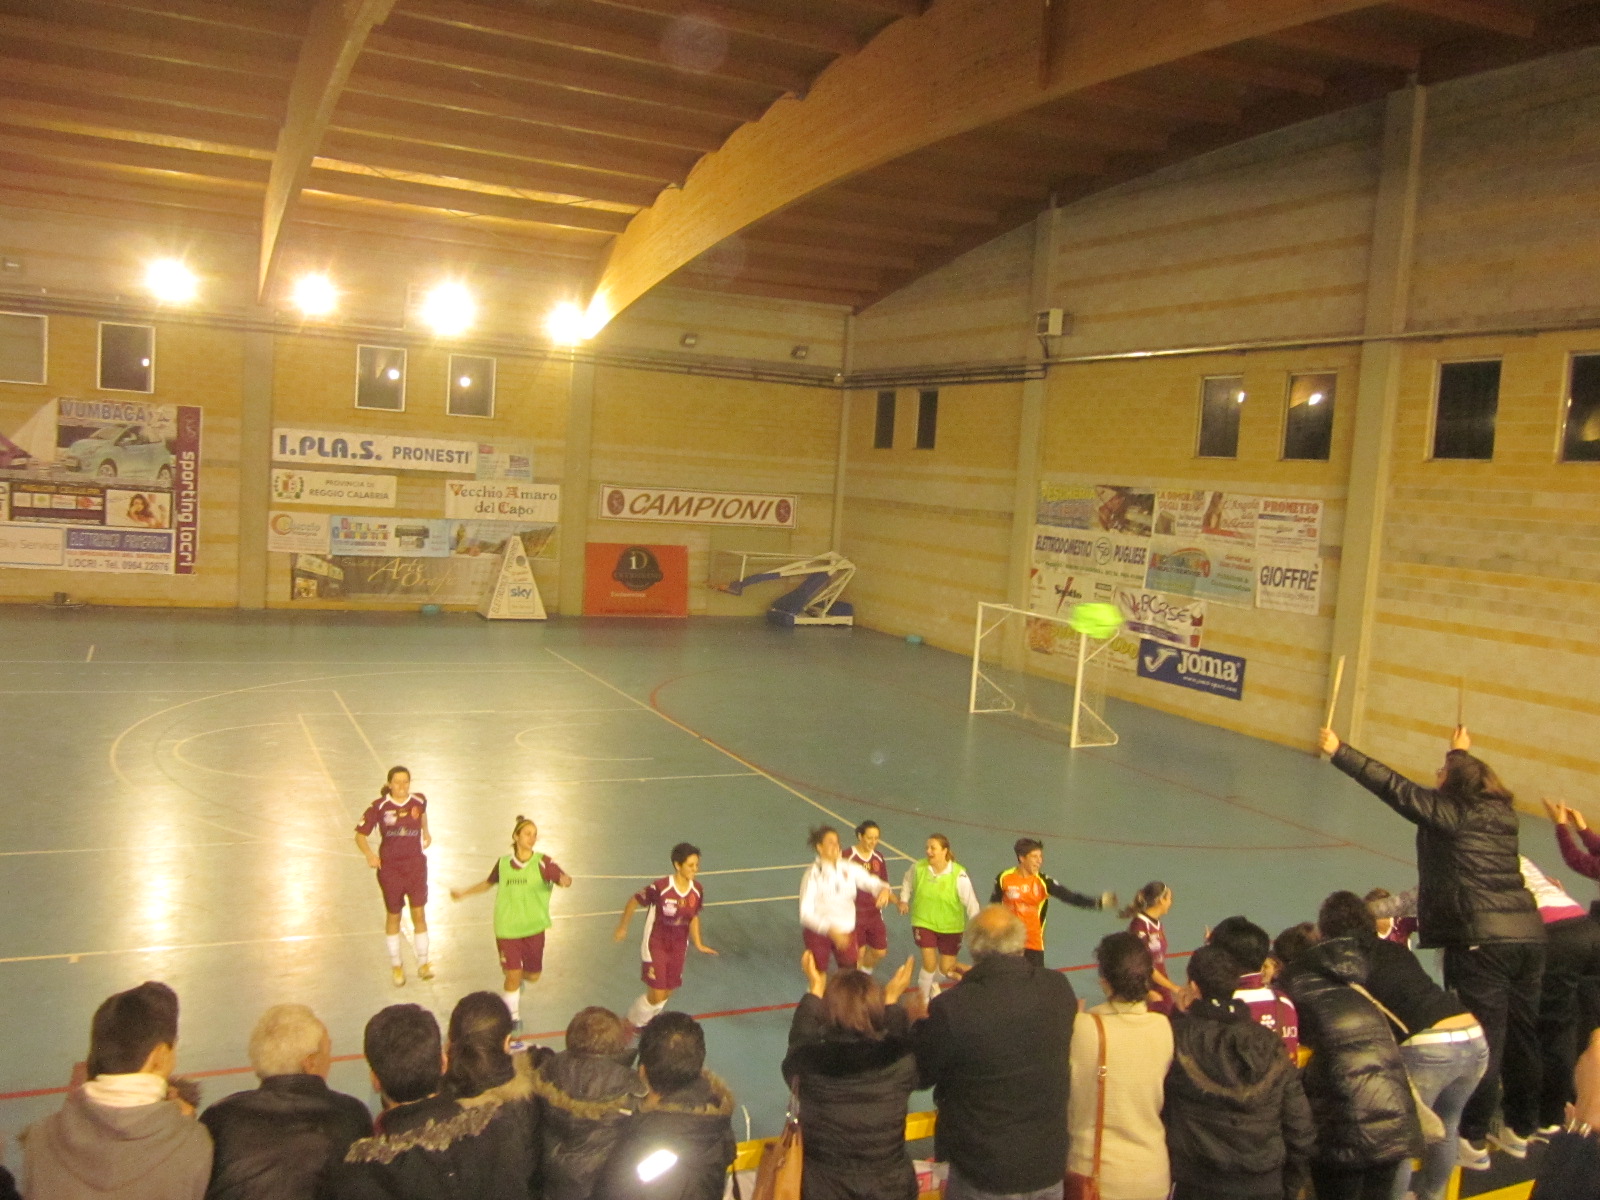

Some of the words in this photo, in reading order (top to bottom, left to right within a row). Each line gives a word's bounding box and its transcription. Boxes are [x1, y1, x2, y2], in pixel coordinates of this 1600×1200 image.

[178, 451, 195, 523] sporting
[308, 488, 344, 498] REGGIO
[346, 490, 389, 500] CALABRIA
[450, 483, 503, 500] Vecchio
[505, 487, 558, 501] Amaro
[475, 501, 496, 515] del
[498, 502, 535, 518] Capo
[629, 493, 774, 520] CAMPIONI
[180, 527, 197, 567] locri
[510, 585, 533, 600] sky
